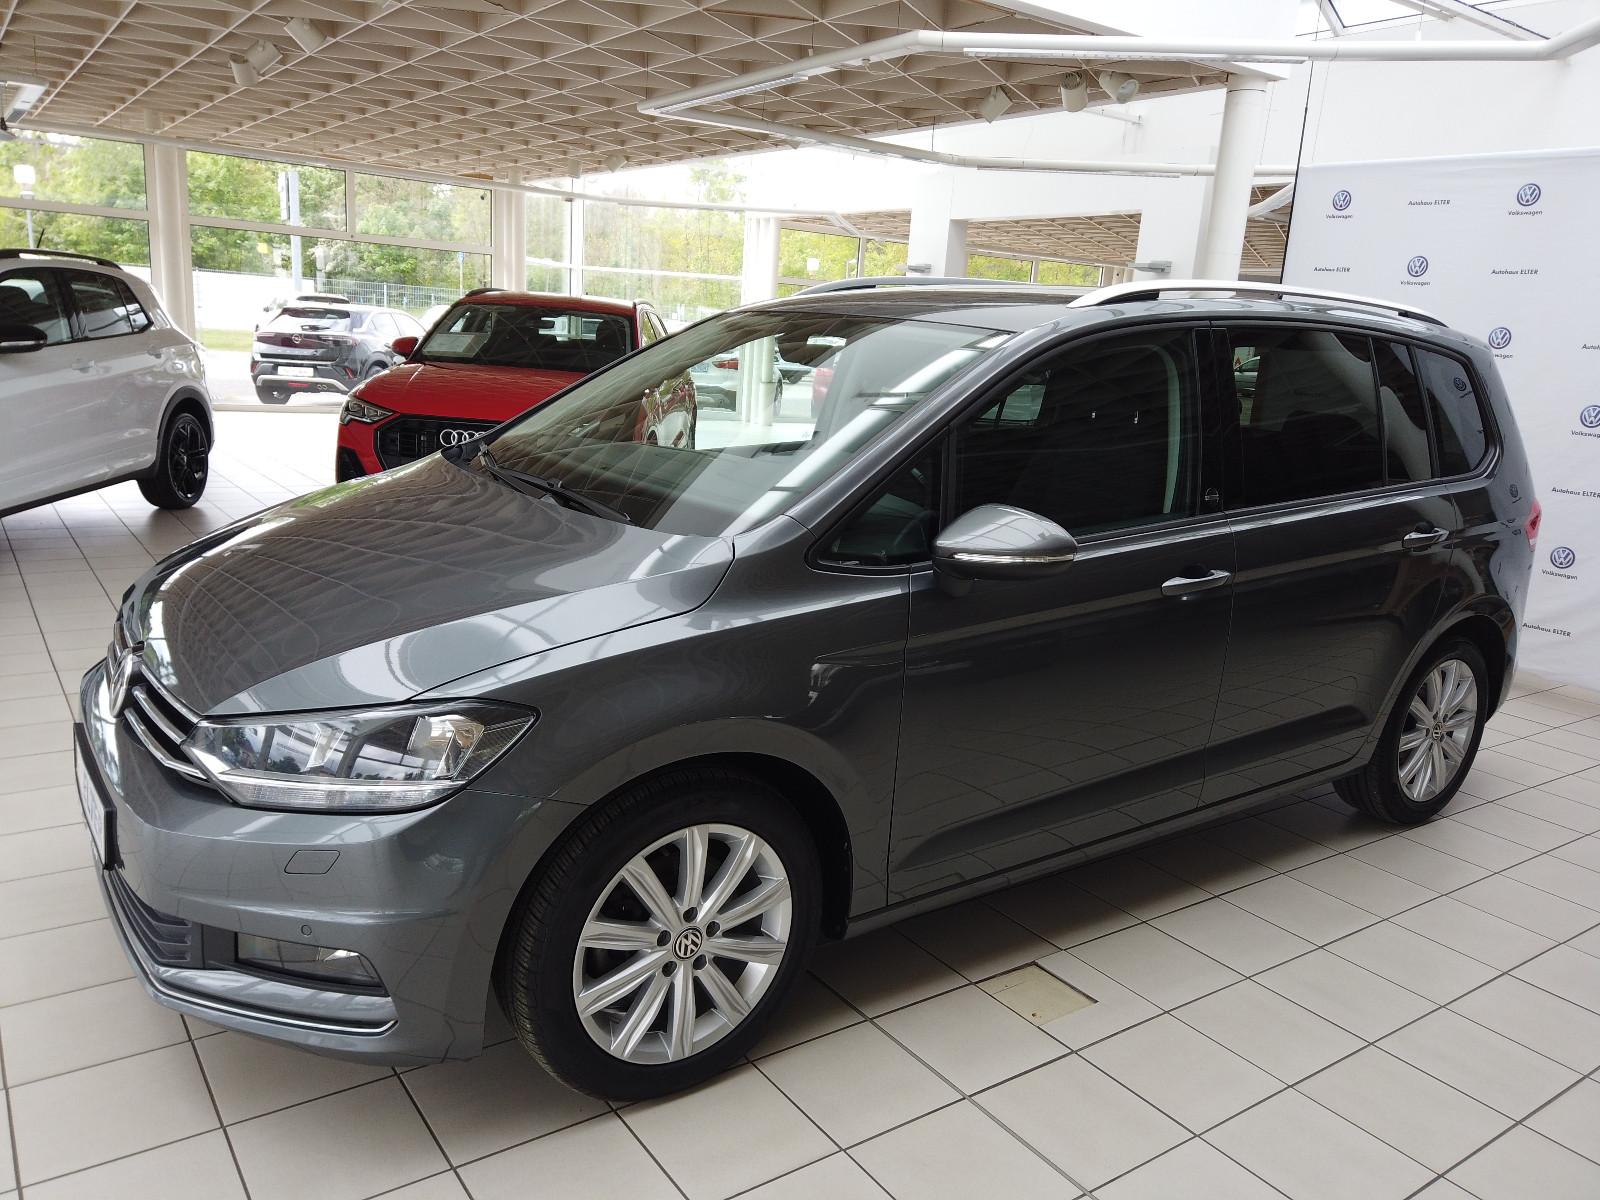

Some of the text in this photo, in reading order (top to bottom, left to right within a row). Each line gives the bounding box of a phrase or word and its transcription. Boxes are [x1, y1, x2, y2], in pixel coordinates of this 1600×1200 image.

[1434, 198, 1451, 206] ELTER
[1508, 209, 1543, 217] Volkswagen
[1490, 268, 1539, 276] Autohaus ELTER
[1400, 279, 1431, 287] Volkswagen
[1571, 430, 1600, 439] Volkswag
[1551, 486, 1600, 499] Autohaus ELTER
[1541, 568, 1578, 581] Volkswagen
[1522, 622, 1572, 638] Autohaus ELTER
